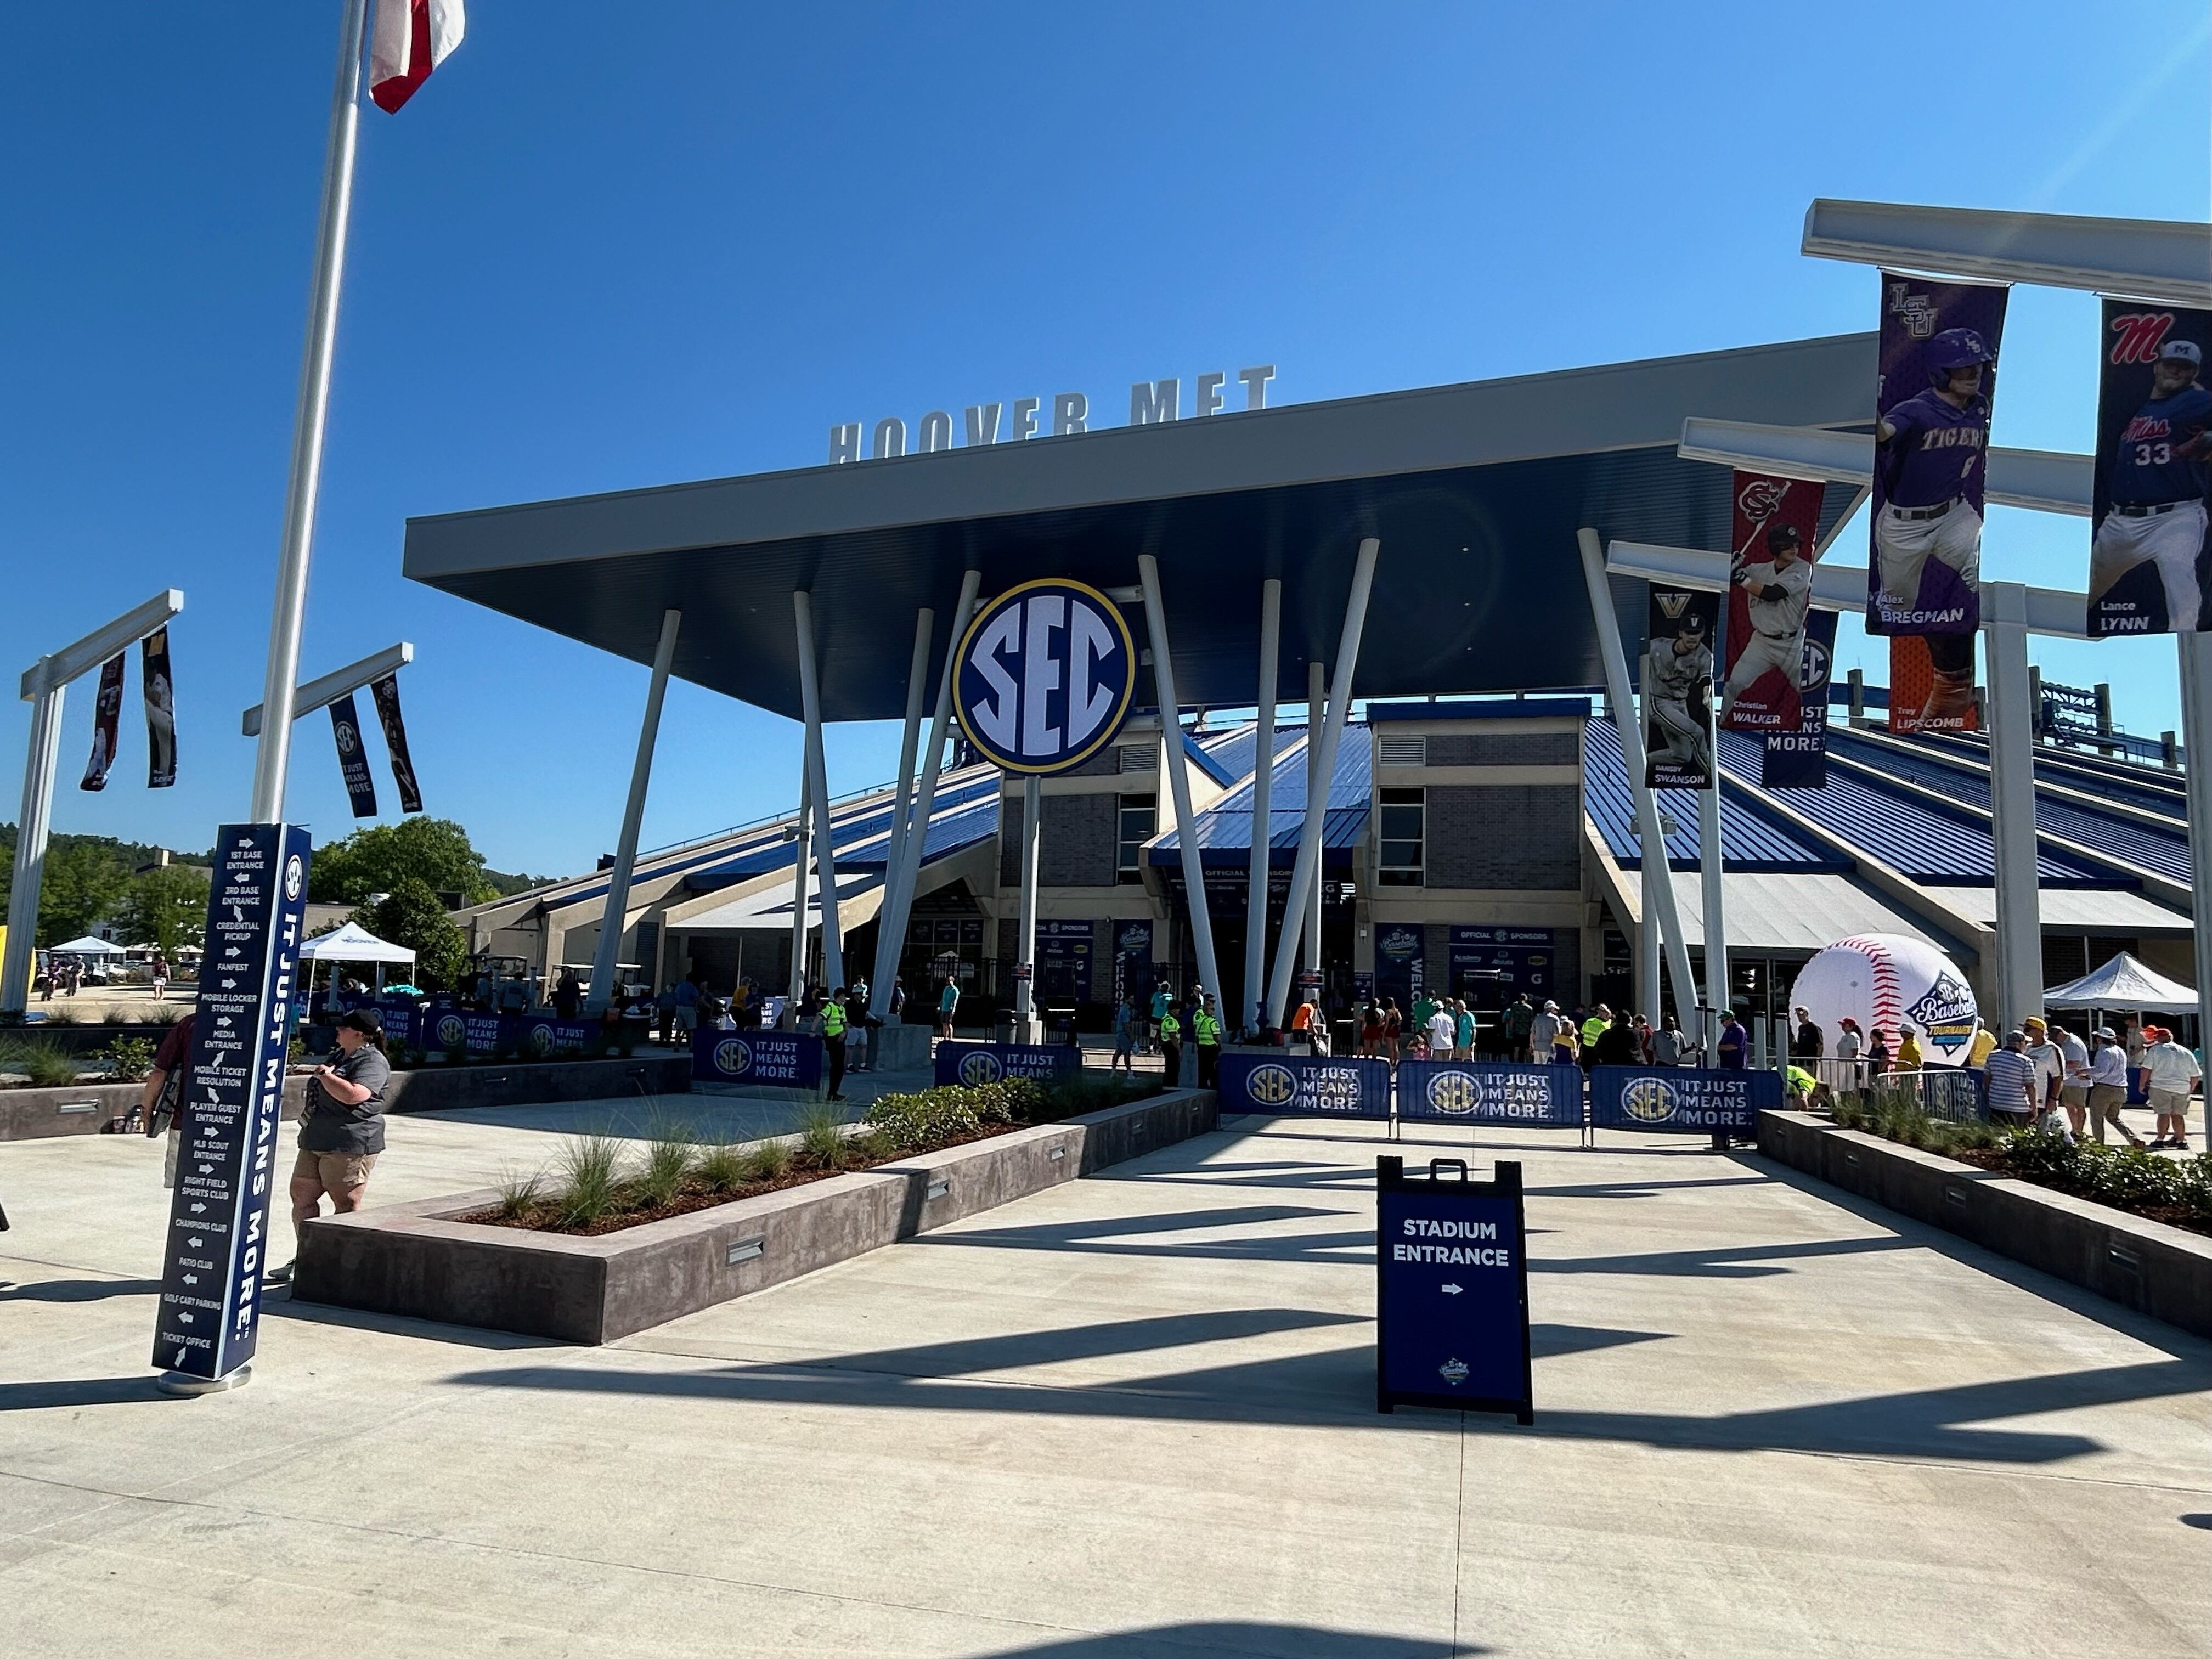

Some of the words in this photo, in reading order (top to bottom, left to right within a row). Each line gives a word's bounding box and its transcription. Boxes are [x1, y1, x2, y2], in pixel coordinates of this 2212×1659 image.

[1889, 283, 1938, 338] LSU
[2111, 312, 2176, 364] M
[828, 392, 1089, 465] HOOVER
[1130, 365, 1276, 426] MET
[2134, 442, 2170, 466] 33
[1881, 594, 1903, 603] Alex
[1655, 593, 1692, 618] V
[2100, 601, 2136, 611] Lance
[1881, 608, 1964, 623] BREGMAN
[2100, 617, 2149, 630] LYNN
[970, 595, 1116, 755] SEC
[1897, 707, 1916, 715] Trey
[1733, 712, 1781, 725] WALKER
[1896, 718, 1964, 729] LIPSCOMB
[1655, 774, 1705, 784] SWANSON
[226, 861, 264, 870] ENTRANCE
[240, 886, 259, 894] BASE
[222, 897, 261, 905] ENTRANCE
[217, 922, 259, 930] CREDENTIAL
[283, 913, 297, 947] IT
[217, 963, 249, 972] FANFEST
[1531, 973, 1542, 985] G
[201, 993, 228, 1002] MOBILE
[229, 994, 257, 1003] LOCKER
[270, 952, 291, 1046] JUST
[211, 1005, 245, 1013] STORAGE
[468, 1018, 476, 1027] IT
[477, 1019, 498, 1029] JUST
[213, 1030, 236, 1039] MEDIA
[441, 1018, 462, 1042] SEC
[466, 1029, 498, 1039] MEANS
[557, 1027, 565, 1036] IT
[565, 1028, 585, 1038] JUST
[205, 1040, 242, 1050] ENTRANCE
[756, 1041, 768, 1051] IT
[768, 1042, 798, 1052] JUST
[719, 1042, 747, 1071] SEC
[755, 1053, 797, 1065] MEANS
[1006, 1053, 1019, 1064] IT
[1020, 1054, 1054, 1065] JUST
[194, 1065, 221, 1075] MOBILE
[222, 1067, 247, 1076] TICKET
[964, 1055, 996, 1085] SEC
[1006, 1066, 1054, 1079] MEANS
[1302, 1066, 1317, 1079] IT
[1319, 1067, 1359, 1080] JUST
[196, 1076, 241, 1087] RESOLUTION
[1253, 1069, 1290, 1102] SEC
[1488, 1074, 1503, 1085] IT
[1506, 1074, 1549, 1086] JUST
[1302, 1081, 1358, 1094] MEANS
[1685, 1081, 1701, 1092] IT
[1702, 1081, 1747, 1093] JUST
[1435, 1075, 1475, 1112] SEC
[1488, 1088, 1549, 1101] MEANS
[1628, 1082, 1671, 1120] SEC
[1685, 1095, 1747, 1109] MEANS
[190, 1102, 217, 1111] PLAYER
[218, 1104, 241, 1114] GUEST
[195, 1113, 234, 1124] ENTRANCE
[252, 1058, 280, 1197] MEANS
[193, 1150, 226, 1161] ENTRANCE
[184, 1176, 206, 1186] RIGHT
[206, 1178, 227, 1188] FIELD
[182, 1187, 208, 1198] SPORTS
[210, 1190, 229, 1200] CLUB
[211, 1223, 227, 1233] CLUB
[1403, 1219, 1497, 1240] STADIUM
[1393, 1244, 1509, 1266] ENTRANCE
[197, 1260, 213, 1269] CLUB
[162, 1331, 185, 1344] TICKET
[186, 1336, 212, 1348] OFFICE
